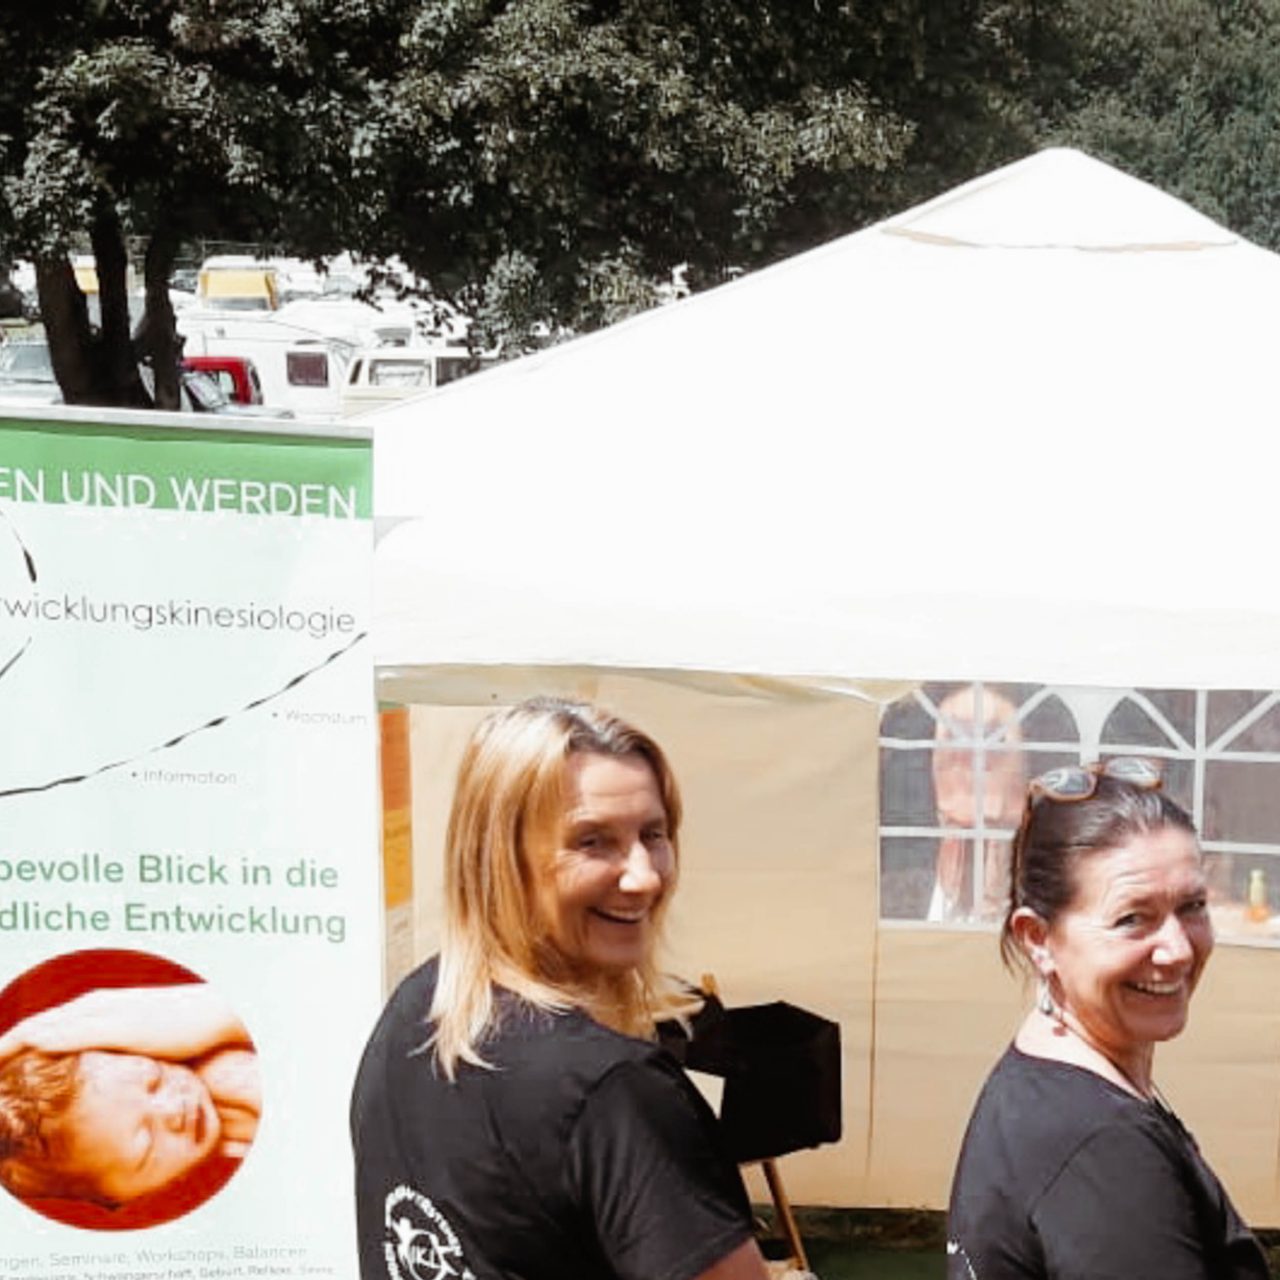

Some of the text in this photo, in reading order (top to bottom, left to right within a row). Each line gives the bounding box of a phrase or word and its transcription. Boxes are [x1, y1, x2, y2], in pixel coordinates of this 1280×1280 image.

[62, 470, 156, 510] UND
[171, 476, 357, 519] WERDEN
[1, 593, 356, 639] wicklungskinesiologie
[143, 769, 237, 785] Information
[138, 855, 229, 885] Blick
[242, 857, 272, 886] in
[286, 859, 339, 888] die
[0, 902, 347, 943] dliche Entwicklung
